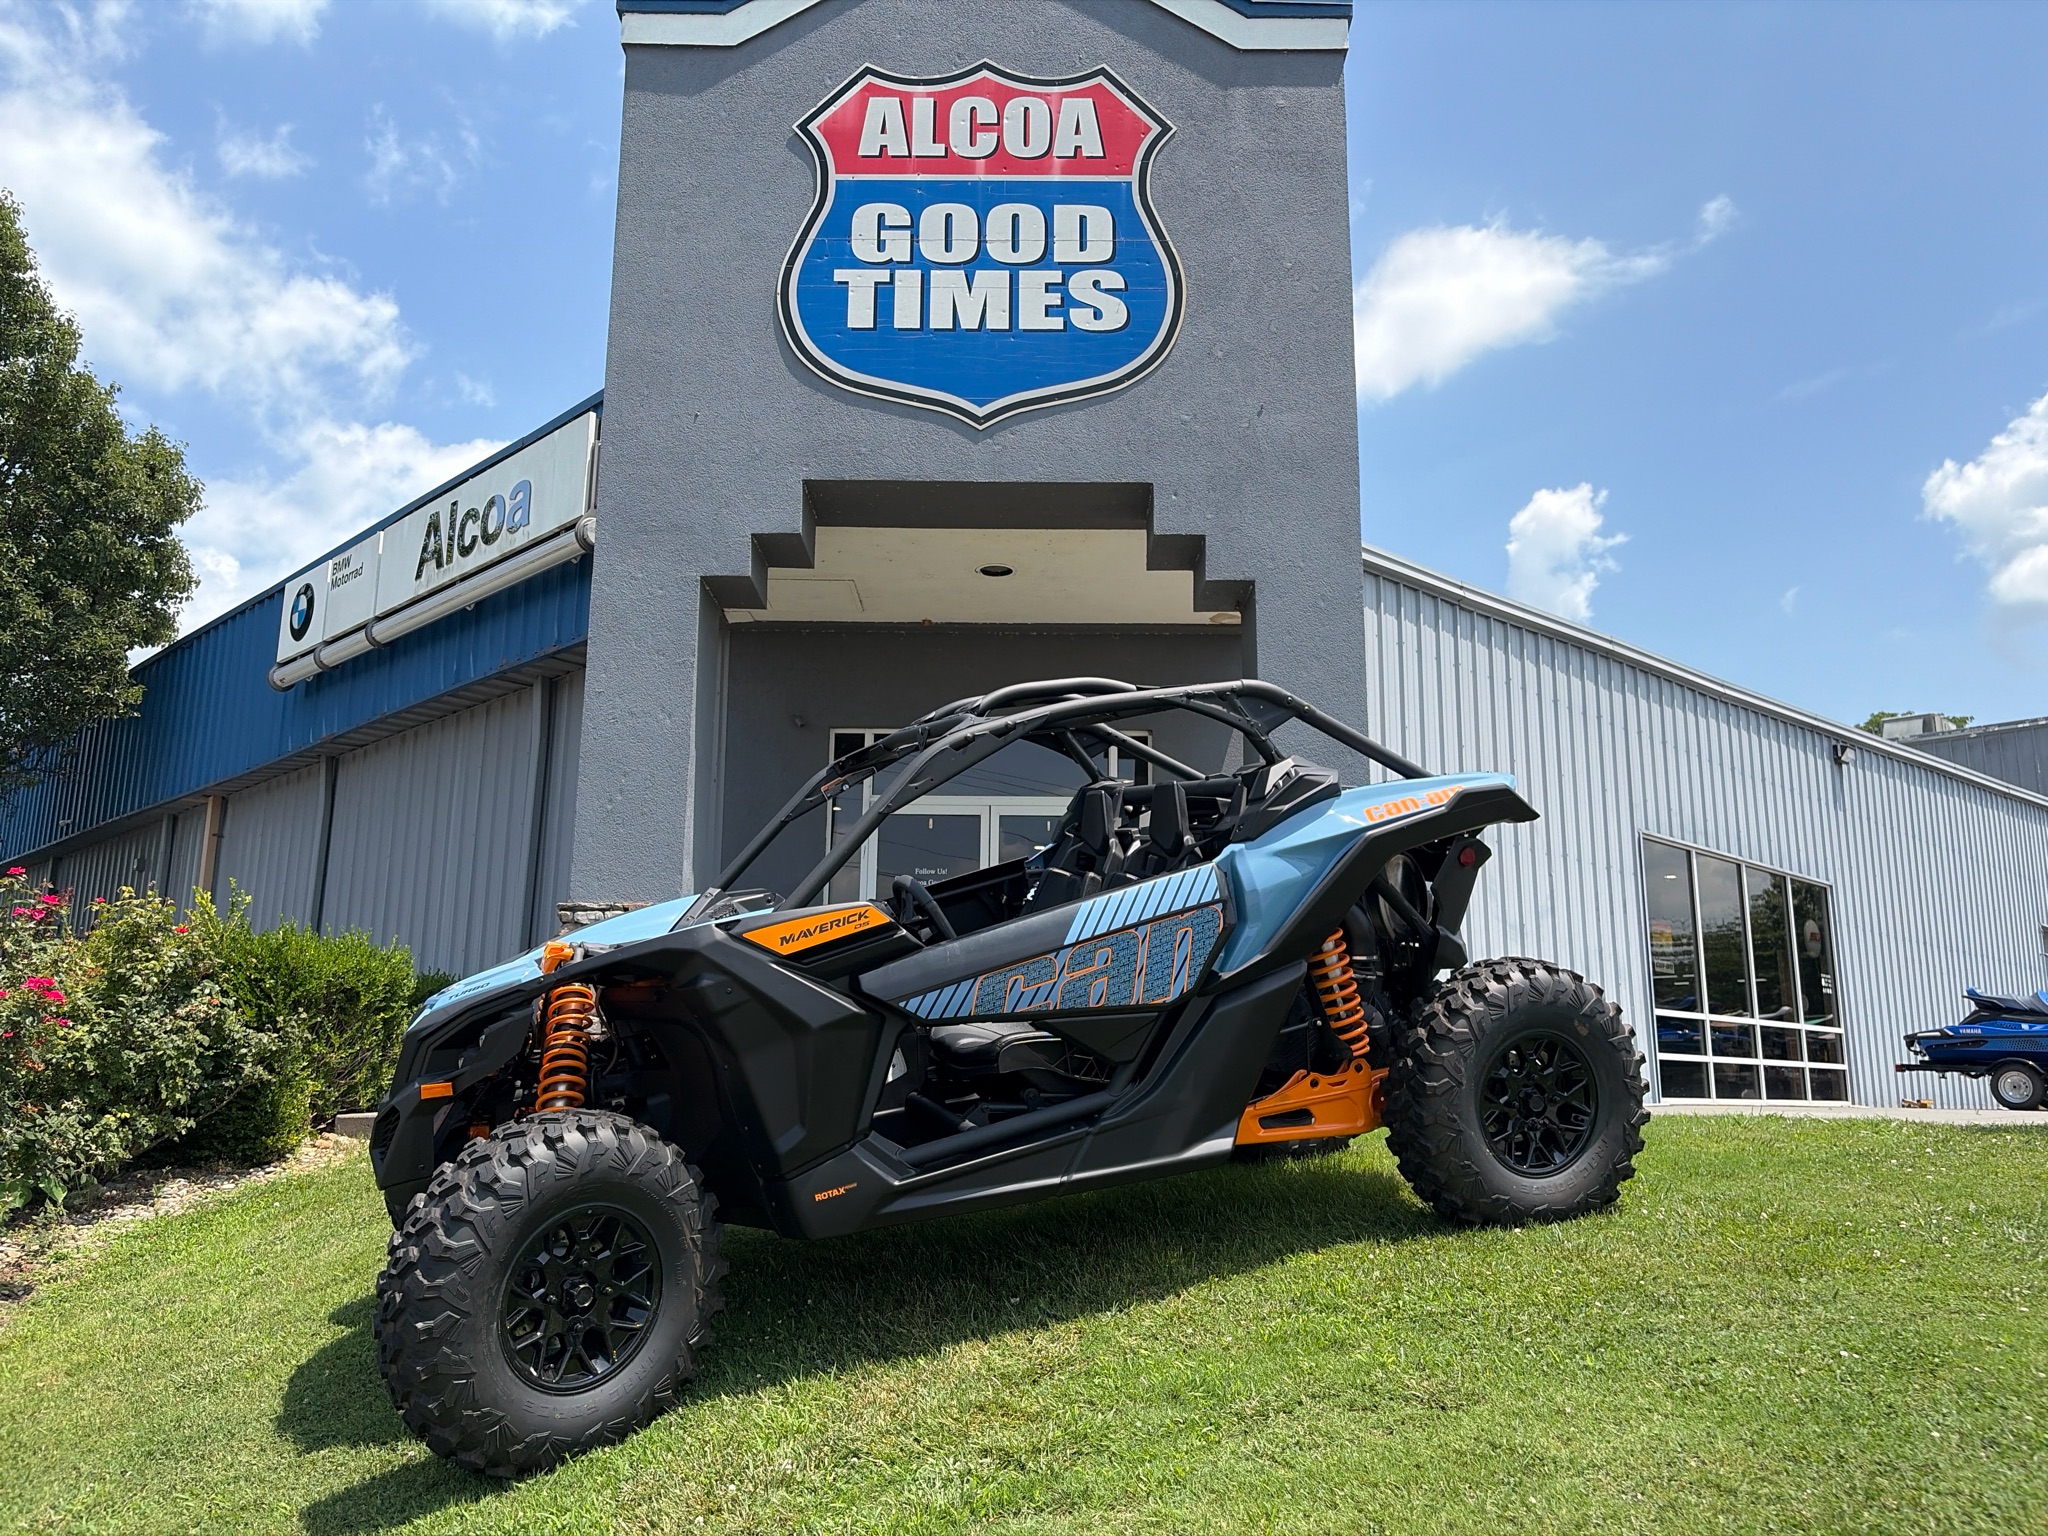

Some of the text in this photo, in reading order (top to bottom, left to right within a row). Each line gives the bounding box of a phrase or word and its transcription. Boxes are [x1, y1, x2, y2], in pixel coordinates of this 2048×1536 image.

[858, 97, 1105, 158] ALCOA
[851, 203, 1116, 264] GOOD
[833, 269, 1129, 331] TIMES
[415, 480, 532, 581] Alcoa
[330, 562, 364, 591] Motorrad
[333, 554, 353, 576] BMW
[779, 909, 871, 946] MAVERICK
[854, 921, 870, 930] DS
[449, 982, 491, 1000] TURBO
[815, 1186, 846, 1201] ROTAX
